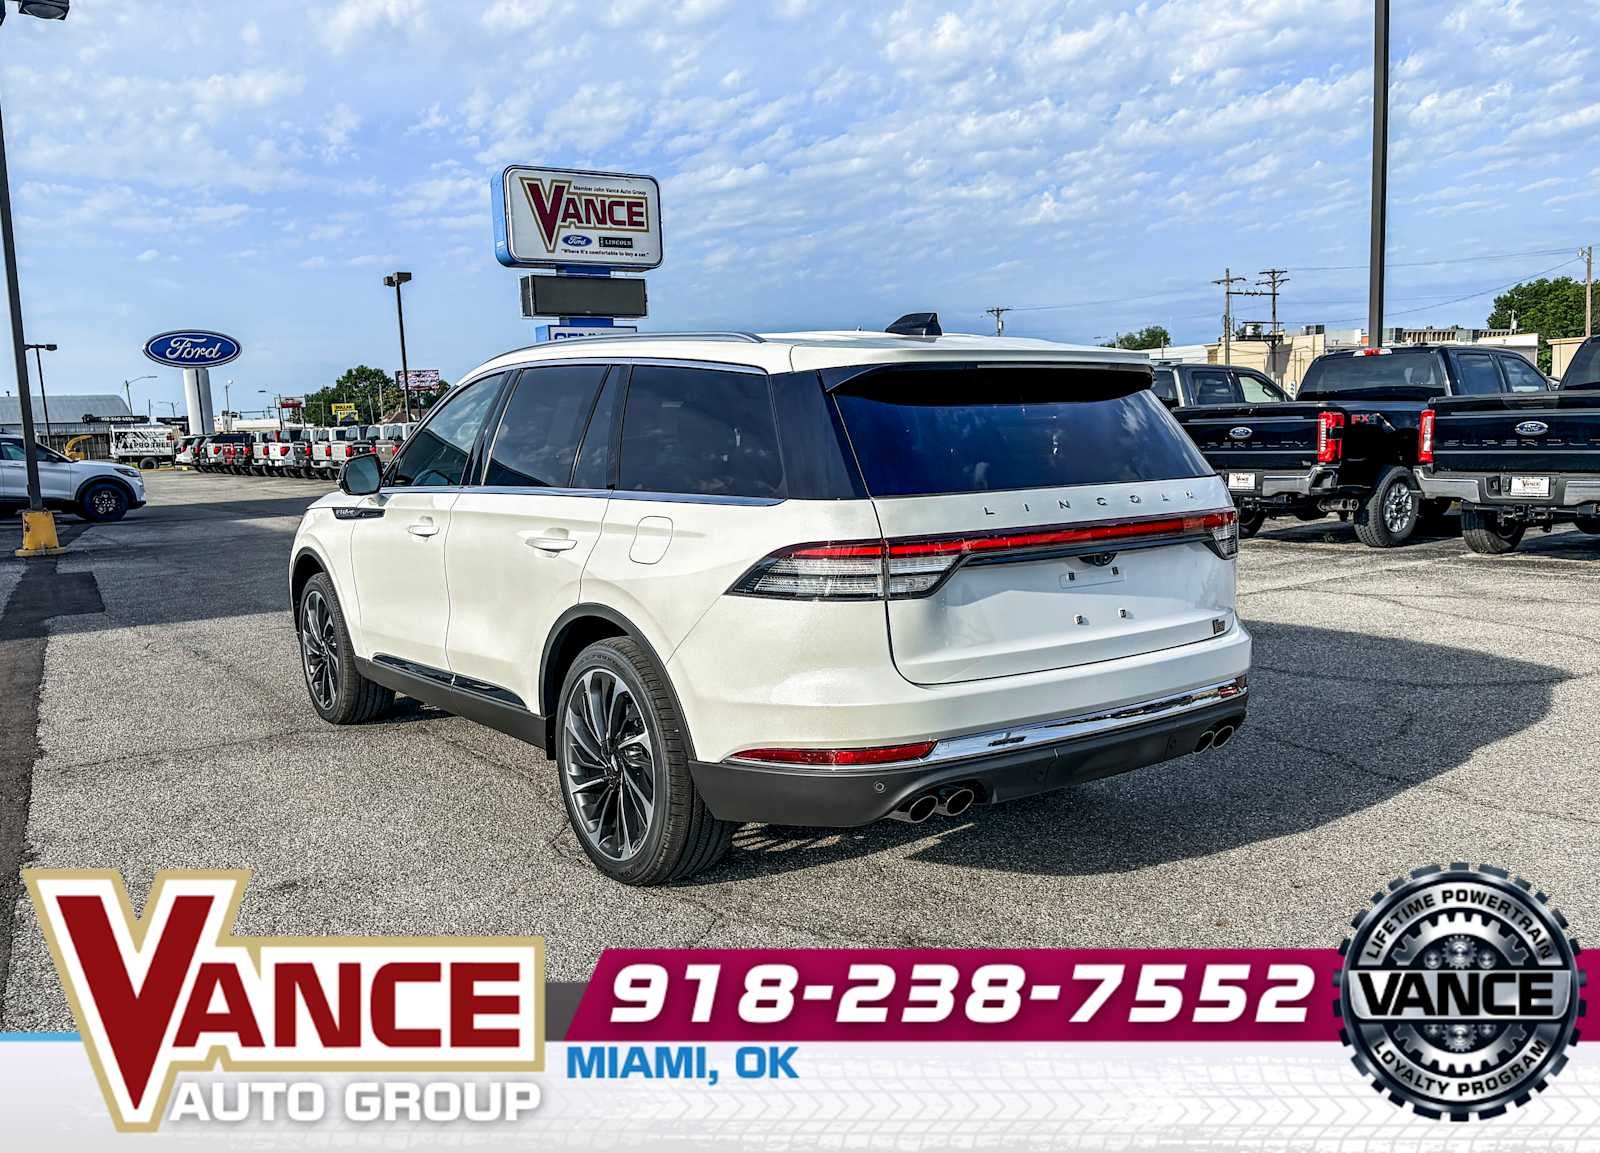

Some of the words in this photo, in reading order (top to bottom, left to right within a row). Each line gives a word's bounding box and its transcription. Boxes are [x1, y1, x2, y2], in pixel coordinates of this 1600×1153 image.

[526, 182, 645, 247] VANCE
[568, 235, 587, 246] Ford
[605, 239, 632, 247] LINCOLN
[165, 337, 222, 359] Ford
[984, 489, 1196, 517] LINCOLN
